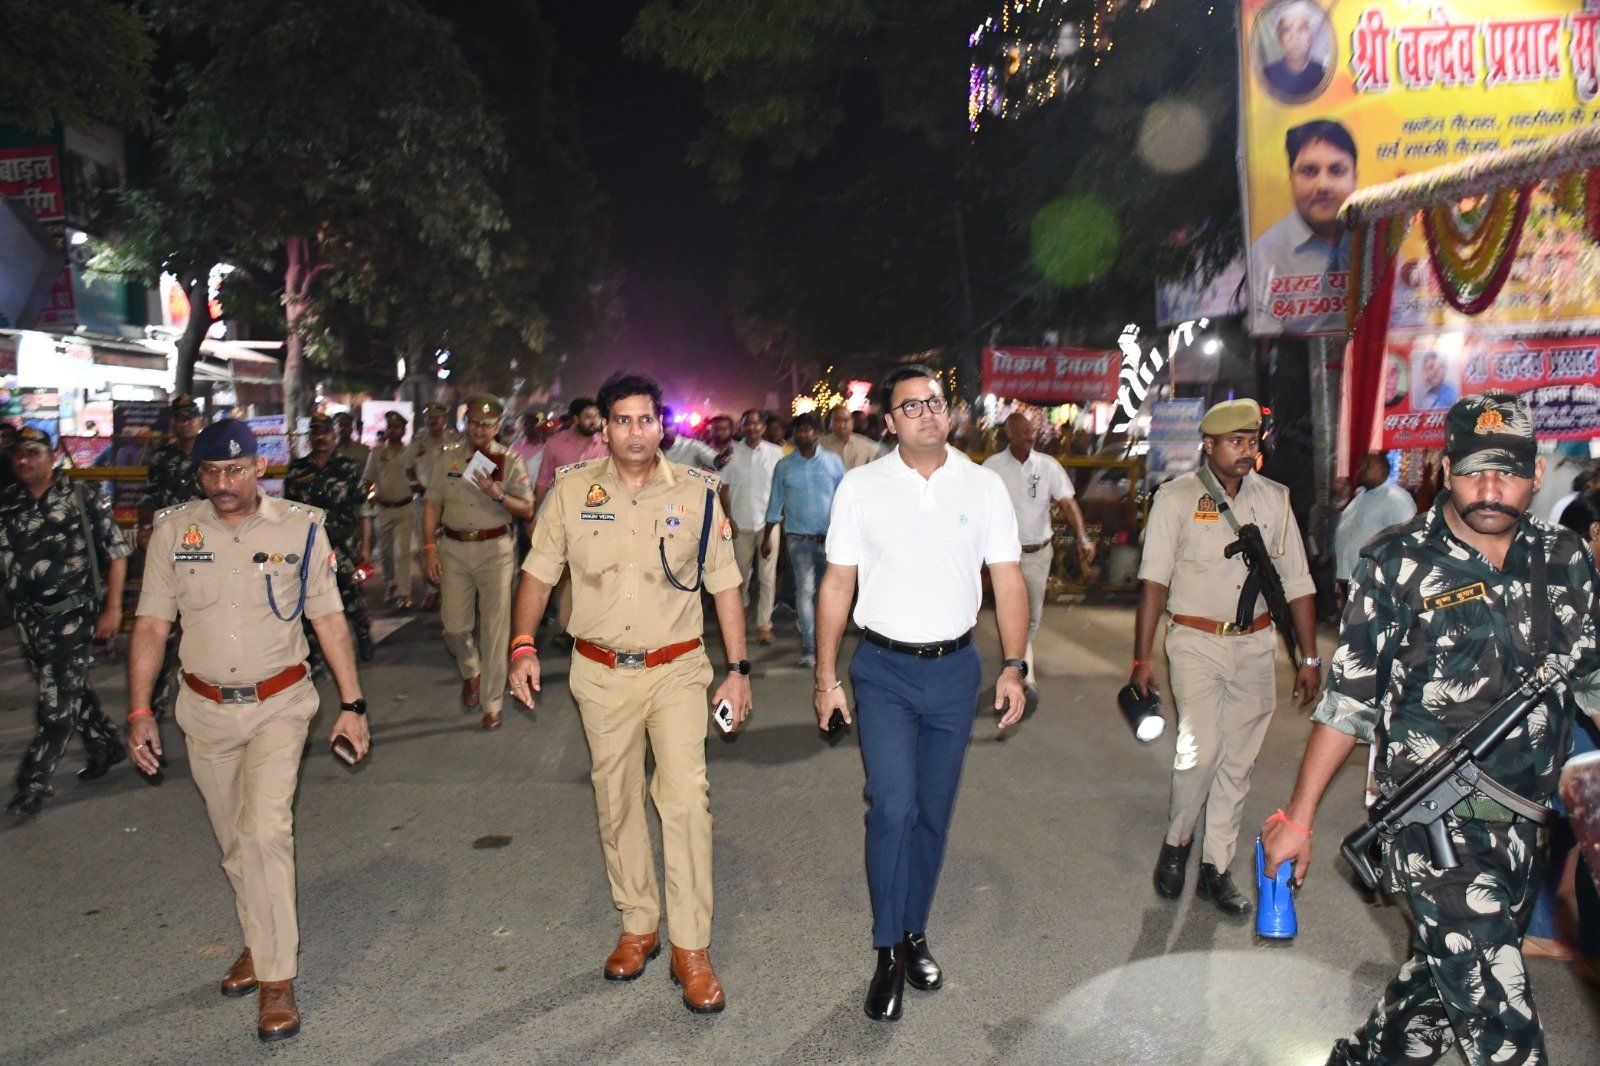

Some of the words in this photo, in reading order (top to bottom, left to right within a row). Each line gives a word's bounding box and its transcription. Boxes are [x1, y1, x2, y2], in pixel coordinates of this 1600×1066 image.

[1352, 6, 1390, 92] श्री
[1484, 15, 1563, 89] प्रसाद
[1568, 11, 1600, 104] सु
[1270, 273, 1322, 294] शरद
[1272, 294, 1349, 318] 8475039
